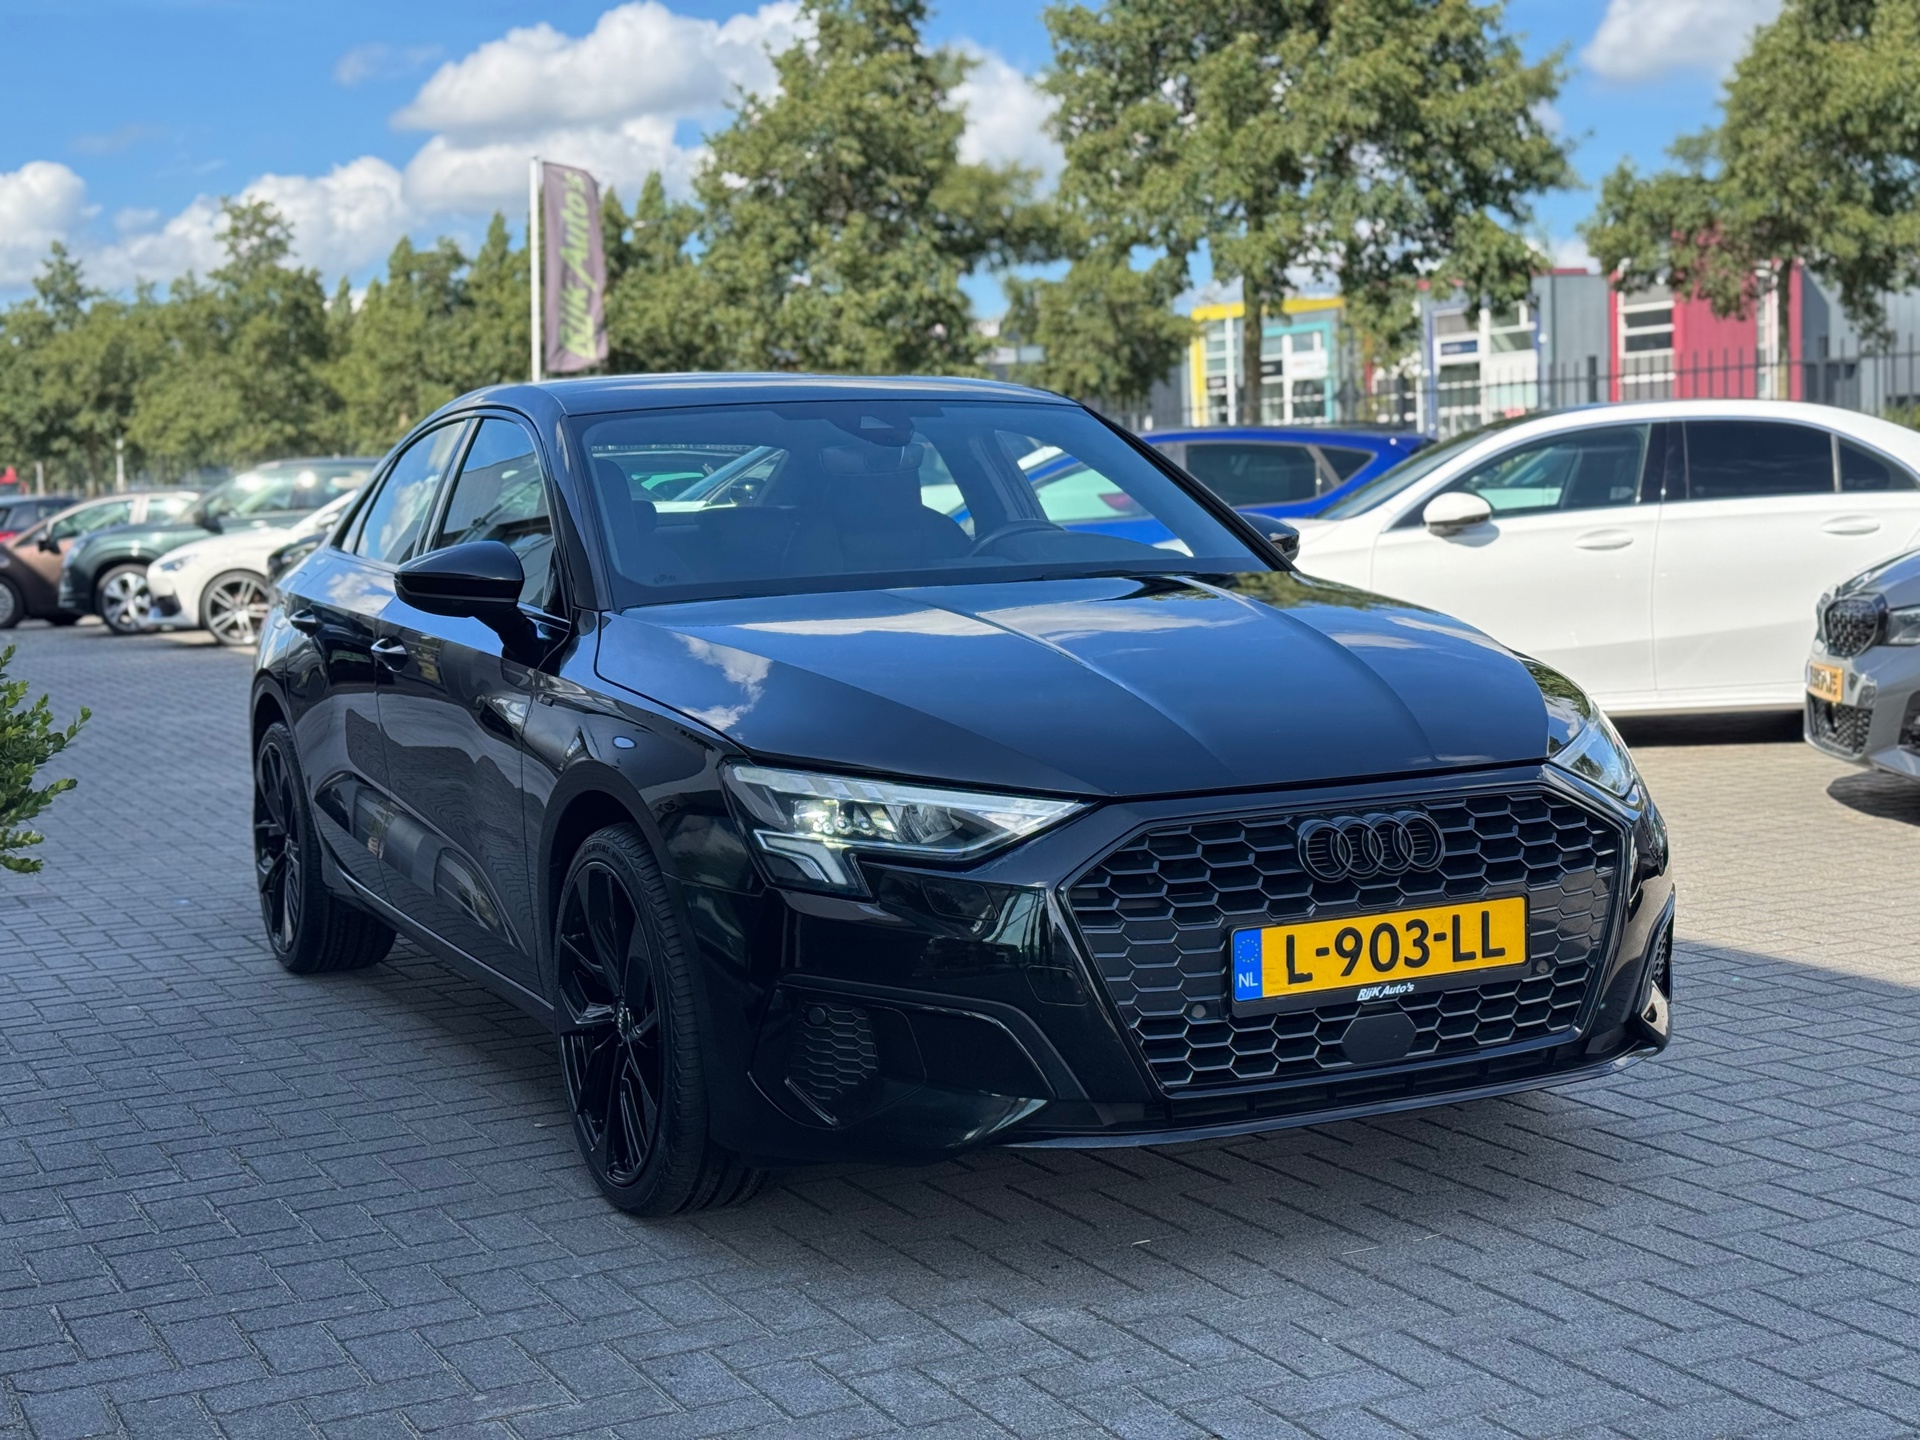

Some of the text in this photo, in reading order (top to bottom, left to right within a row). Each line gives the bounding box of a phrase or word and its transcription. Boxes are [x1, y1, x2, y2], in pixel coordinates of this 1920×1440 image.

[1286, 910, 1506, 985] L-903-LL
[1238, 971, 1259, 988] NL
[1378, 982, 1415, 998] Auto's
